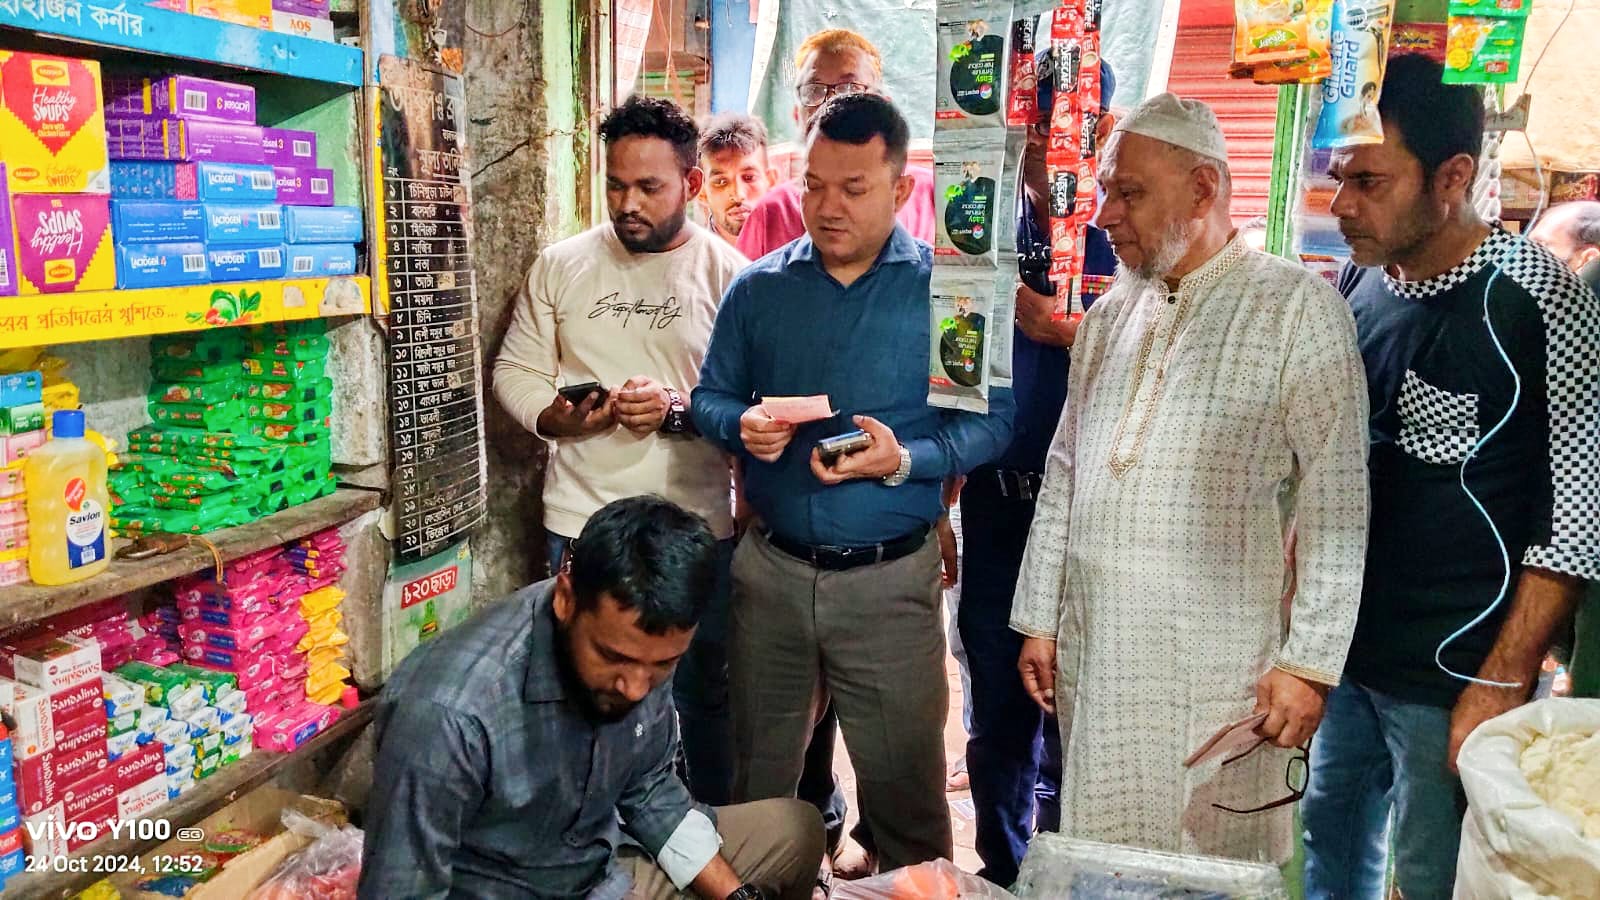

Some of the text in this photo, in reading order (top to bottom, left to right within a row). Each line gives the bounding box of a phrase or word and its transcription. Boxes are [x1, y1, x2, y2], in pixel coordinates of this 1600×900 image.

[88, 3, 144, 37] কর্নার
[1340, 39, 1361, 98] Guard
[975, 74, 993, 83] Easy
[32, 87, 76, 110] Healthy
[389, 184, 396, 197] ১
[390, 206, 398, 217] ২
[968, 214, 985, 224] Easy
[391, 224, 398, 234] ৩
[30, 227, 83, 256] Healthy
[393, 241, 400, 252] ৪
[393, 260, 400, 269] ৫
[394, 275, 434, 289] ৬ আটা
[396, 296, 402, 307] ৭
[37, 305, 113, 330] প্রতিদিনের
[396, 310, 432, 323] ৮ চিনি
[397, 330, 404, 340] ৯
[396, 349, 407, 359] ১০
[396, 367, 408, 379] ১১
[397, 384, 409, 395] ১২
[398, 400, 409, 411] ১৩
[399, 416, 410, 428] ১৪
[400, 433, 412, 445] ১৫
[401, 450, 413, 462] ১৬
[402, 467, 414, 479] ১৭
[404, 483, 416, 496] ১৮
[69, 510, 101, 525] Savlon
[405, 518, 417, 529] ২০
[406, 535, 417, 546] ২১
[51, 687, 100, 712] Sandalina
[56, 748, 105, 775] Sandalina
[118, 752, 161, 777] Sandalina
[42, 752, 55, 804] Sandalina
